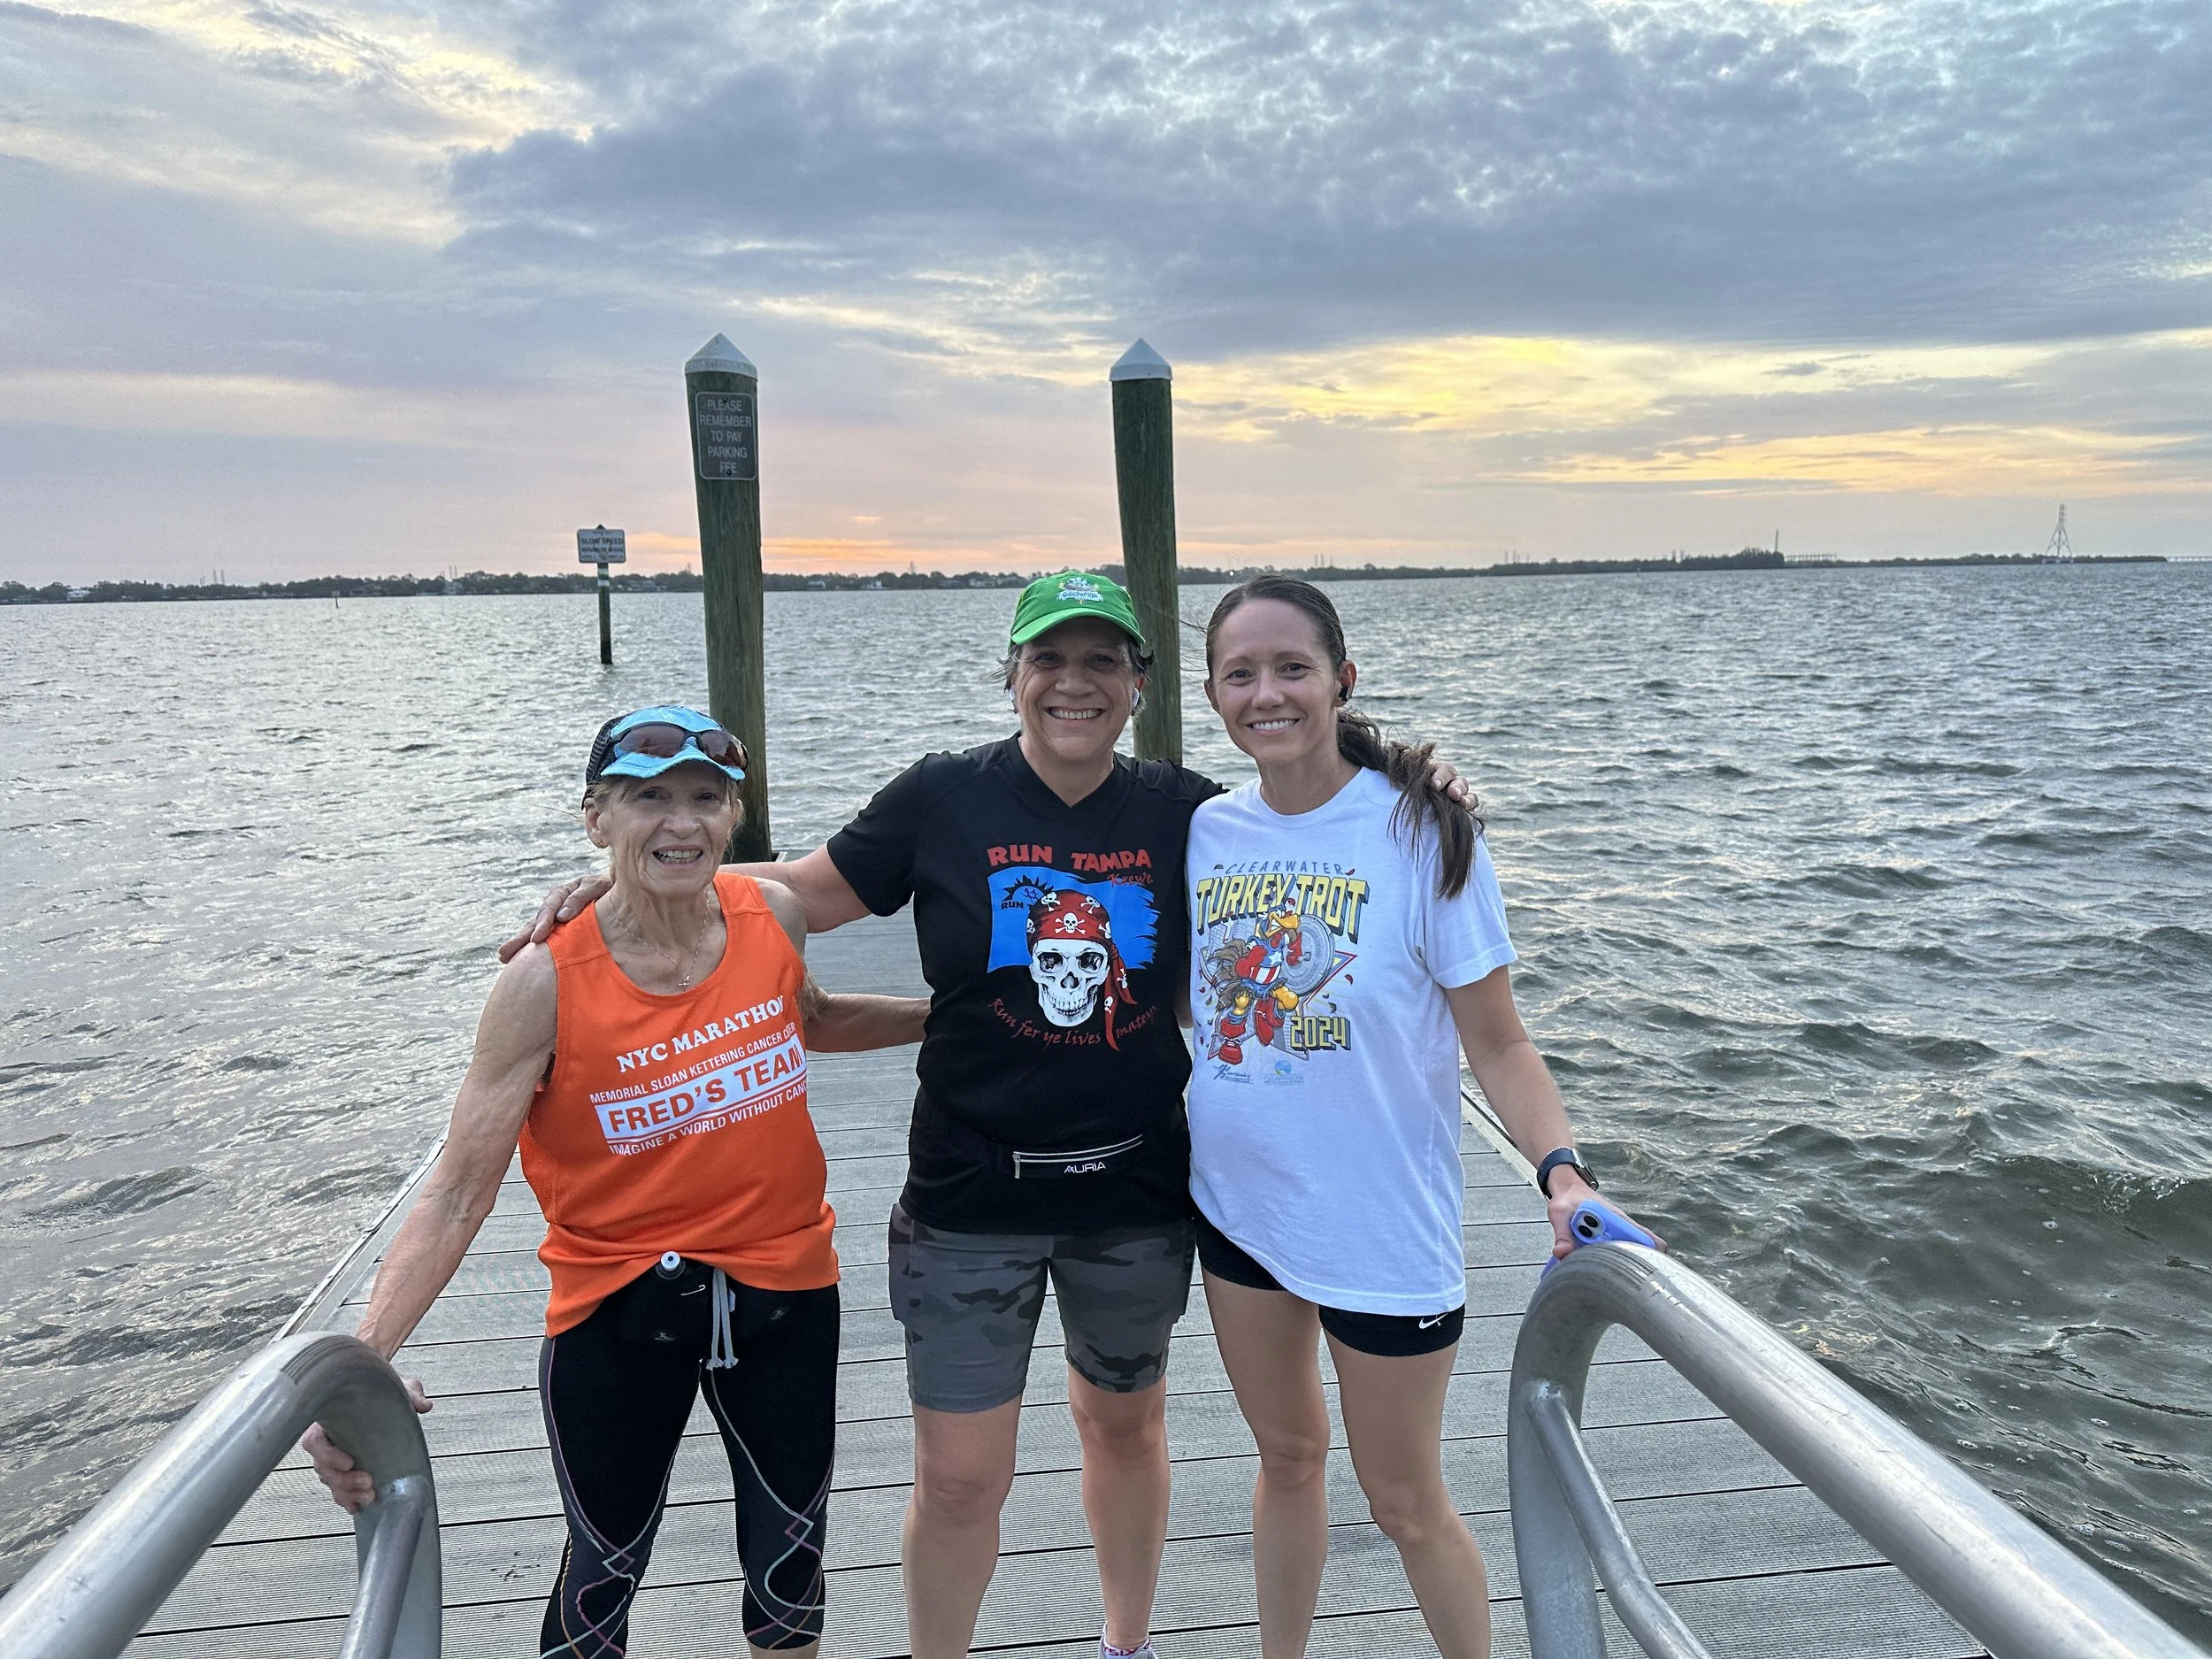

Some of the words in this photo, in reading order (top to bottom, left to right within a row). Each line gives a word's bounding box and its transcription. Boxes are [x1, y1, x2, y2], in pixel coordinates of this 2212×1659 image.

[708, 399, 742, 411] PLEASE
[700, 414, 751, 427] REMEMBER
[710, 430, 723, 442] TO
[726, 431, 742, 442] PAY
[708, 446, 748, 458] PARKING
[987, 844, 1053, 866] RUN
[1071, 849, 1153, 872] TAMPA
[1225, 861, 1343, 875] CLEARWATER
[1107, 872, 1154, 888] Krewe
[1001, 901, 1024, 910] RUN
[1197, 873, 1296, 935] TURKEY
[1296, 874, 1370, 944] TROT
[988, 997, 1016, 1027] Run
[1010, 1020, 1041, 1038] fer
[1042, 1032, 1062, 1050] ye
[1064, 1030, 1102, 1046] lives
[1290, 1017, 1351, 1050] 2024
[589, 1084, 648, 1104] MEMORIAL
[651, 1070, 687, 1090] SLOAN
[690, 1047, 745, 1078] KETTERING
[747, 1033, 782, 1055] CANCER
[617, 1044, 669, 1072] NYC
[608, 1078, 726, 1133] FRED'S
[733, 1044, 803, 1093] TEAM
[609, 1135, 664, 1156] IMAGINE
[668, 1131, 677, 1142] A
[681, 1116, 726, 1136] WORLD
[729, 1094, 783, 1124] WITHOUT
[1064, 1161, 1106, 1173] AURIA
